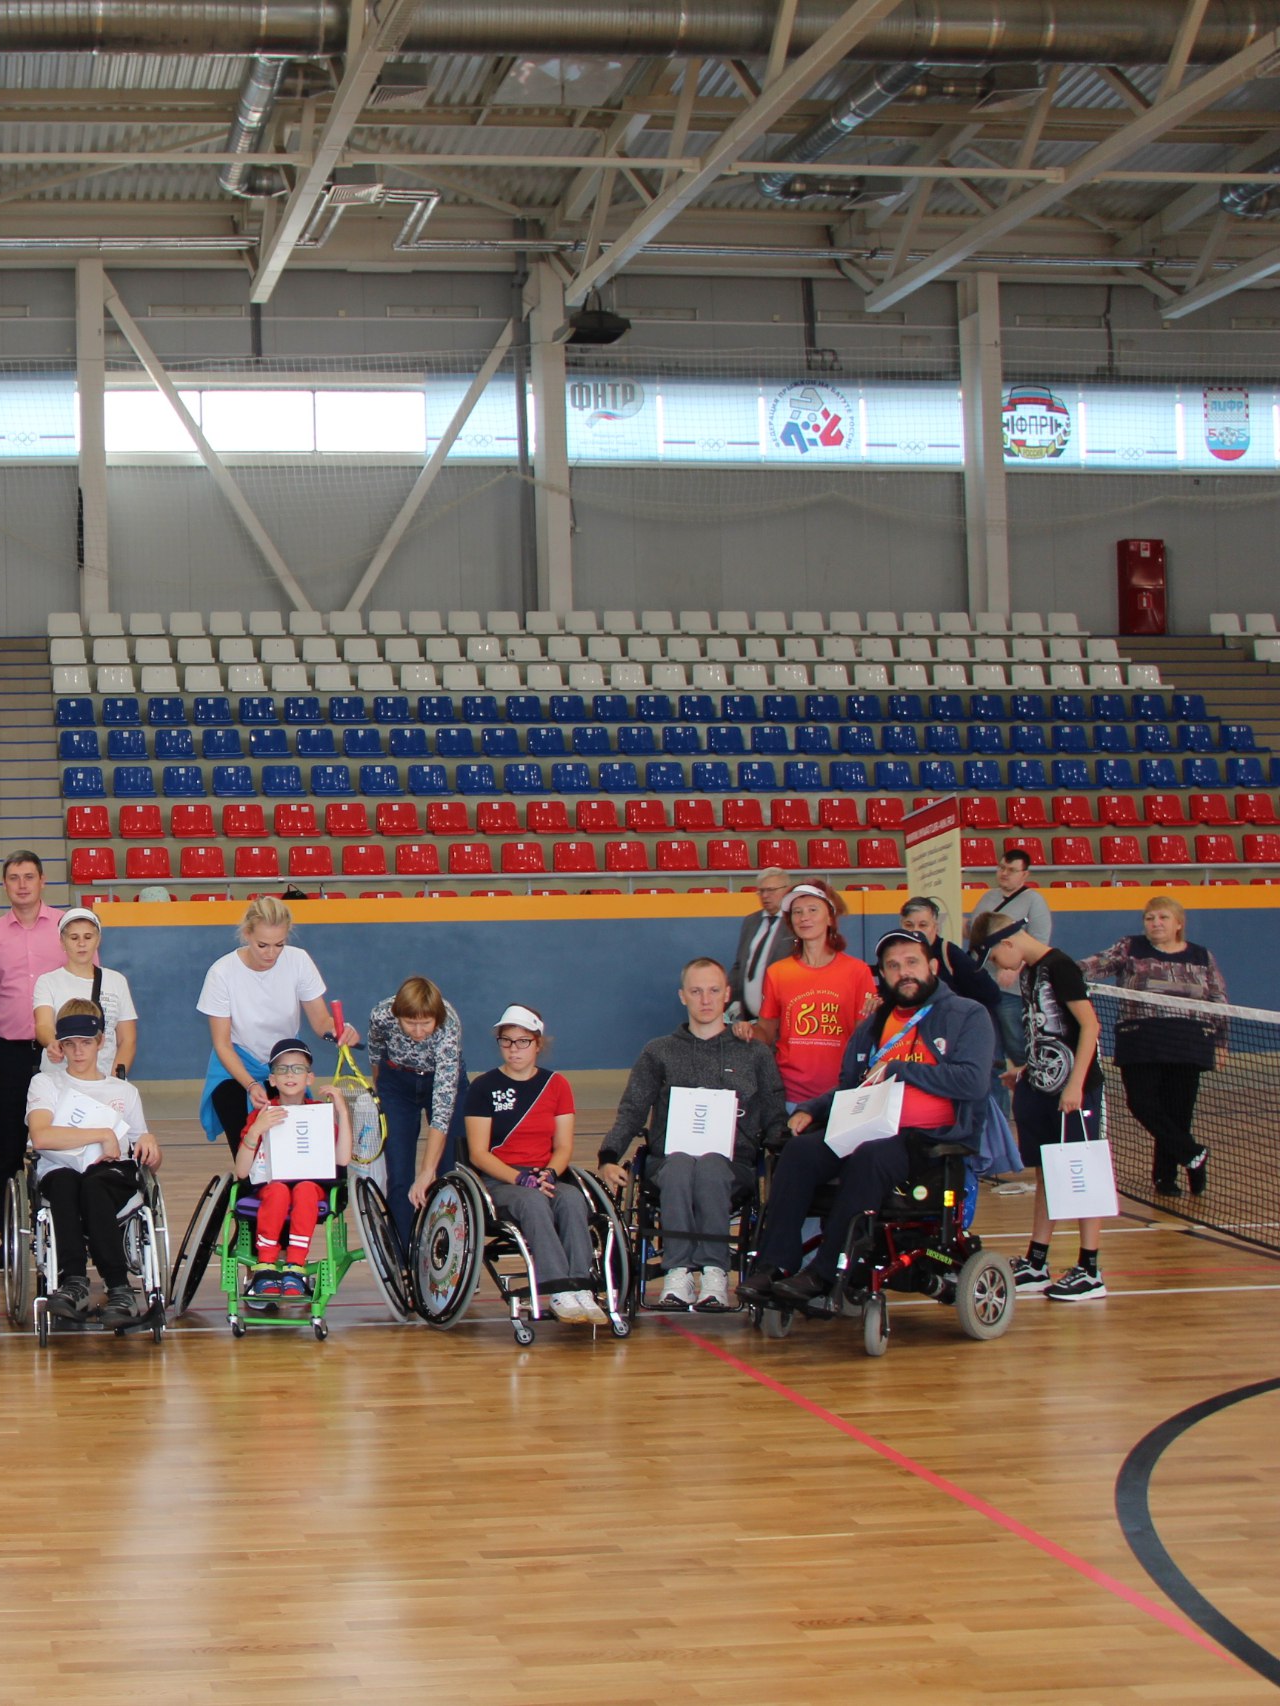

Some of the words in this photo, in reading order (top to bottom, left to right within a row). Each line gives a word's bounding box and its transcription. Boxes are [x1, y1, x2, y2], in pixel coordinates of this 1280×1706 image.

[570, 382, 634, 411] ФНТР
[821, 1002, 839, 1013] ИН
[821, 1013, 838, 1024] ВА
[820, 1024, 843, 1035] ТУР
